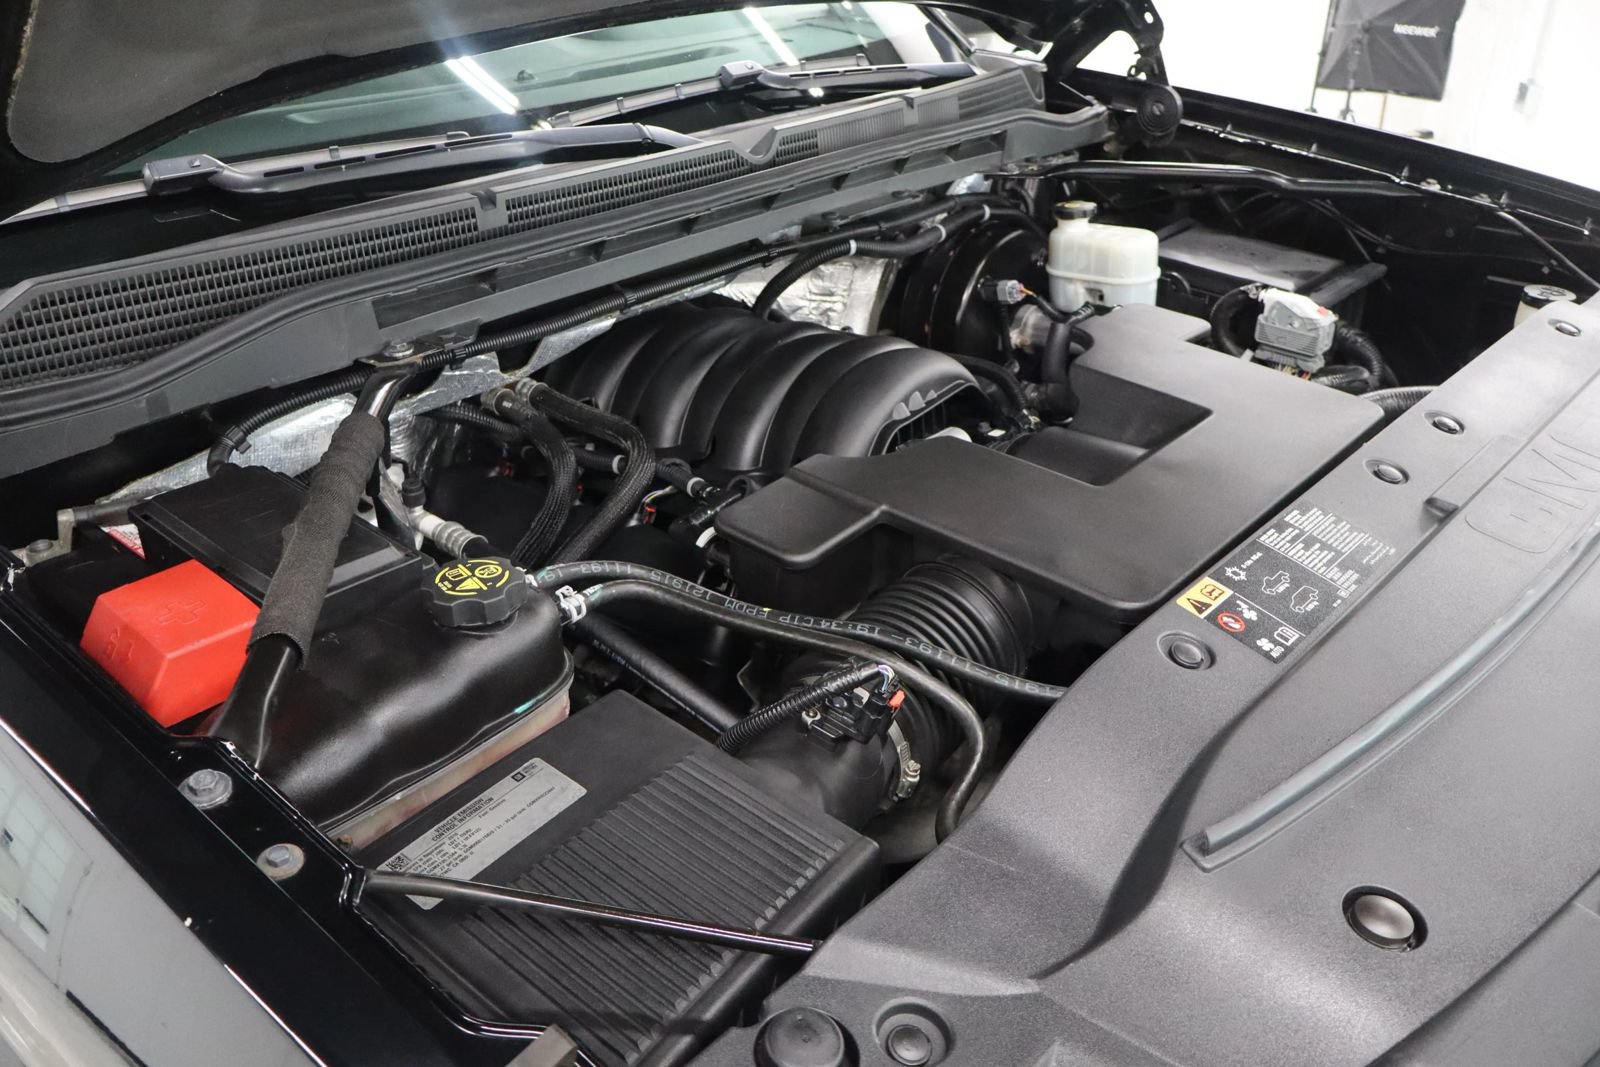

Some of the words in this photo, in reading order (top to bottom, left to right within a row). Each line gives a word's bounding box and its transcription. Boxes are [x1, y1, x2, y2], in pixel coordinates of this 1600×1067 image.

[725, 599, 768, 617] EPDM
[431, 822, 458, 842] CONTROL
[458, 796, 494, 824] INFORMATION
